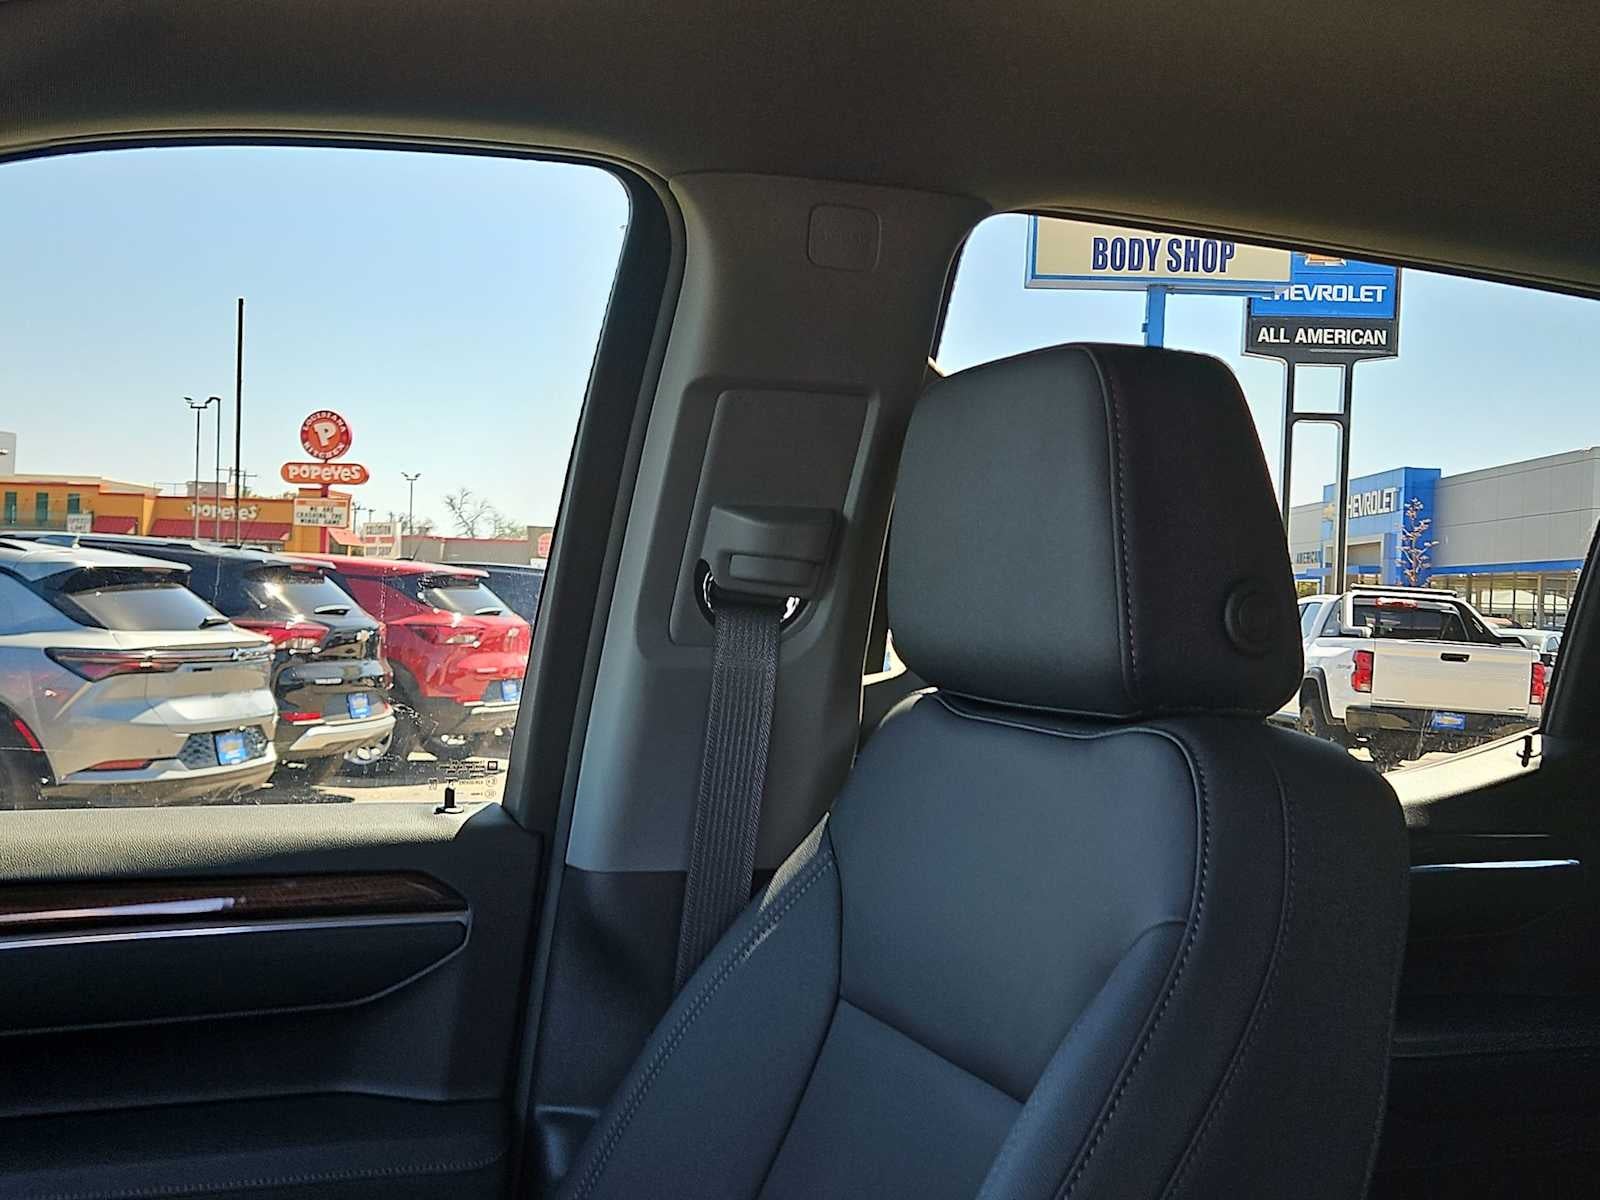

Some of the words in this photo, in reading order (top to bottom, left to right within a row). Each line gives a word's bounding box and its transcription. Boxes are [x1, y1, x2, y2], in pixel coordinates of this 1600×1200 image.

[1091, 236, 1161, 271] BODY
[1166, 238, 1235, 273] SHOP
[1262, 284, 1387, 302] HEVROLET
[1257, 327, 1290, 343] ALL
[1294, 328, 1387, 345] AMERICAN
[1346, 487, 1396, 519] HEVROLET
